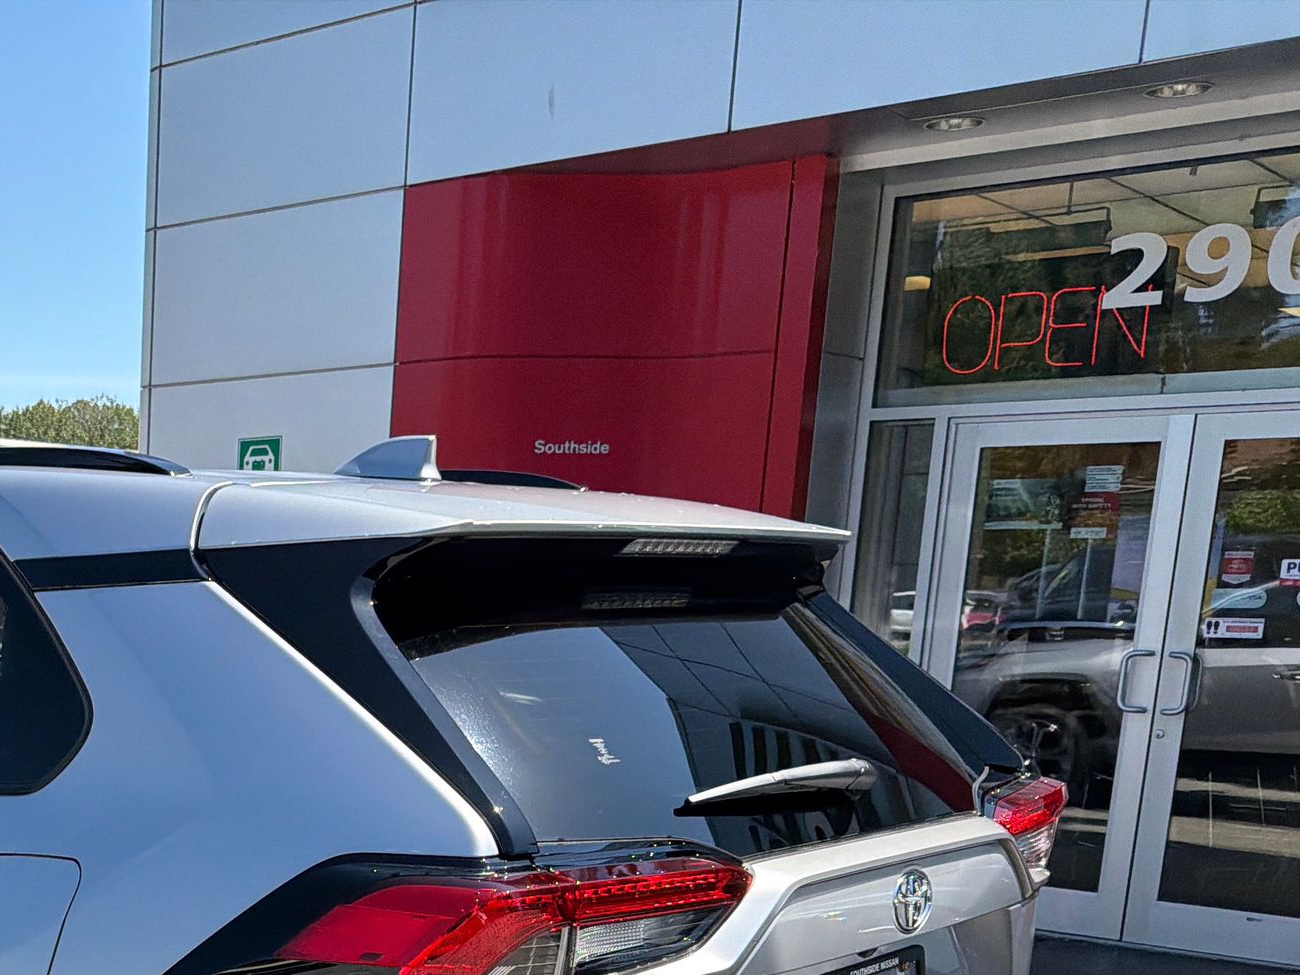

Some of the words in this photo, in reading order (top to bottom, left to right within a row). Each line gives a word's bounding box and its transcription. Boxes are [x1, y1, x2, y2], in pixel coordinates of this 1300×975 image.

[942, 283, 1154, 374] OPEN
[534, 440, 610, 455] Southside
[880, 957, 899, 969] NISSAN
